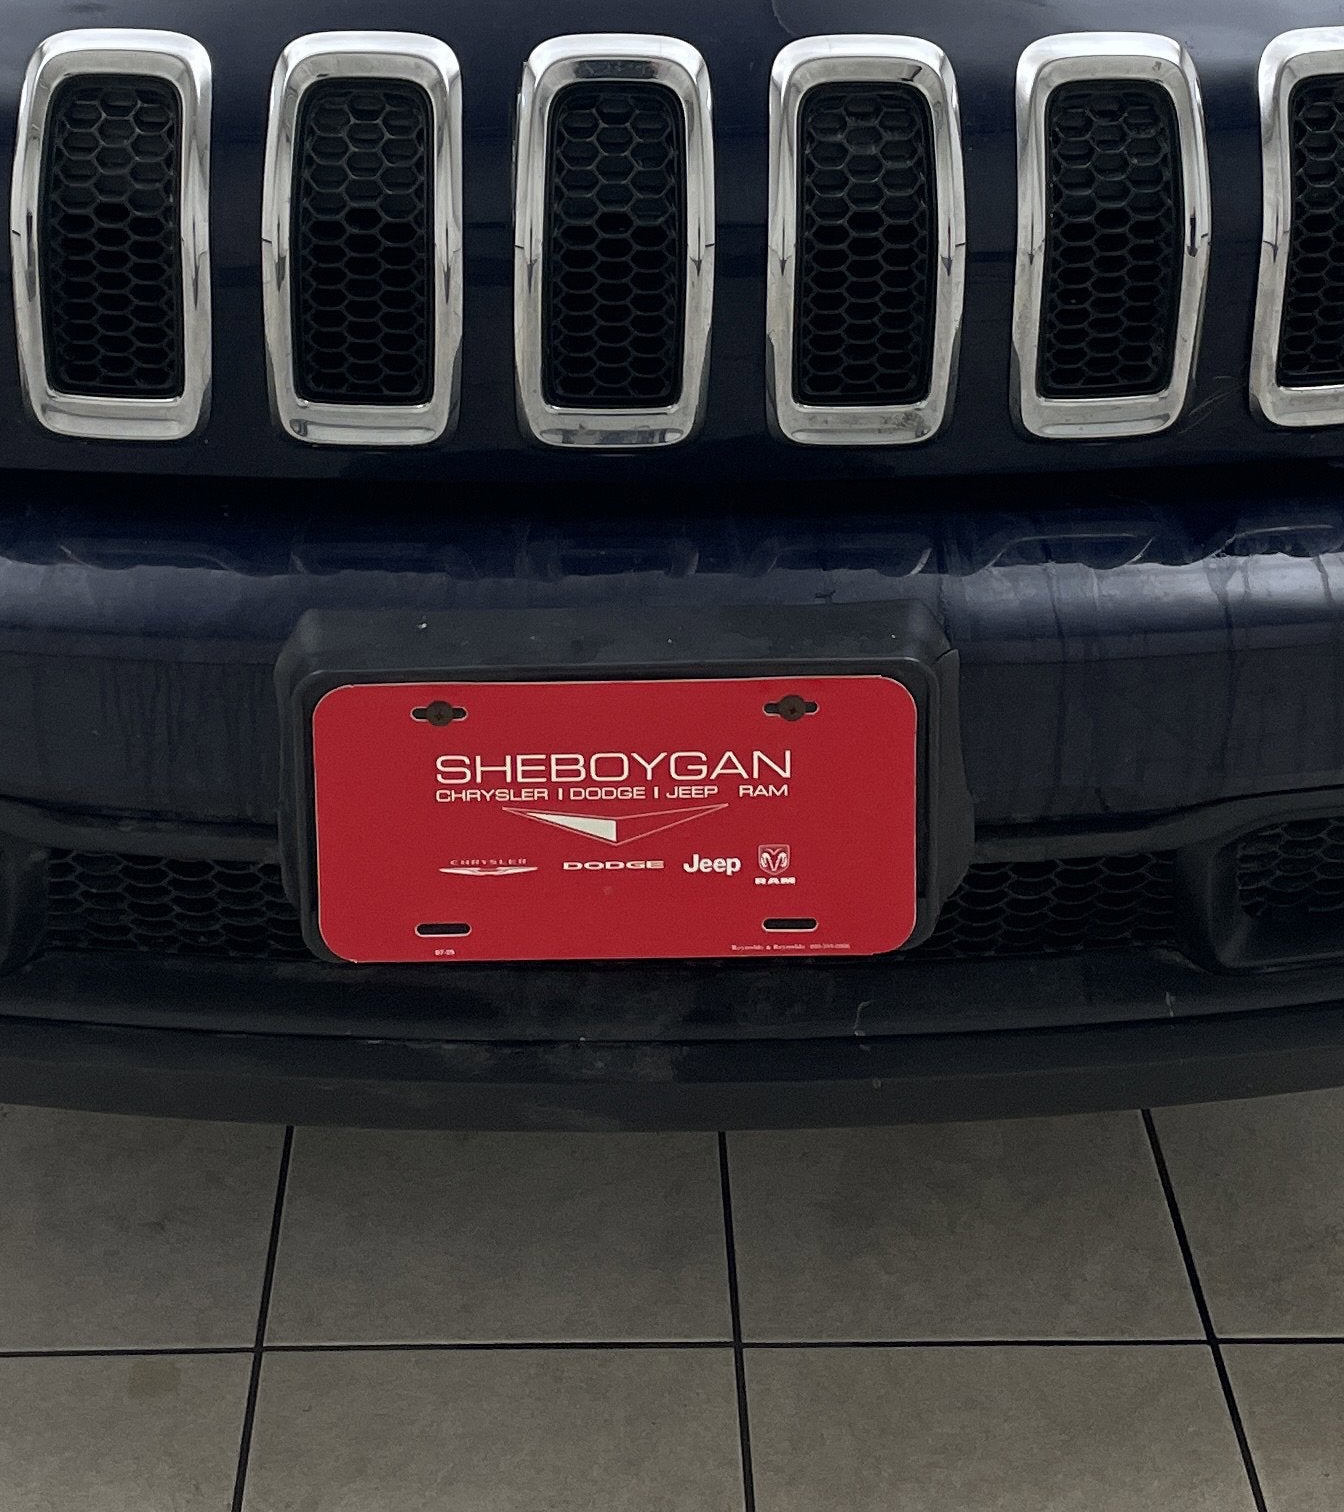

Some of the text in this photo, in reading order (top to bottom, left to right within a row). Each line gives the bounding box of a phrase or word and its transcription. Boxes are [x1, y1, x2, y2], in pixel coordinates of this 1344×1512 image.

[435, 749, 792, 784] SHEBOYGAN
[435, 788, 549, 803] CHRYSLER
[570, 786, 646, 801] DODGE
[666, 785, 719, 799] JEEP
[739, 784, 789, 798] RAM
[450, 853, 742, 876] CHRYSLER DODGE Jeep
[754, 876, 796, 886] RAM
